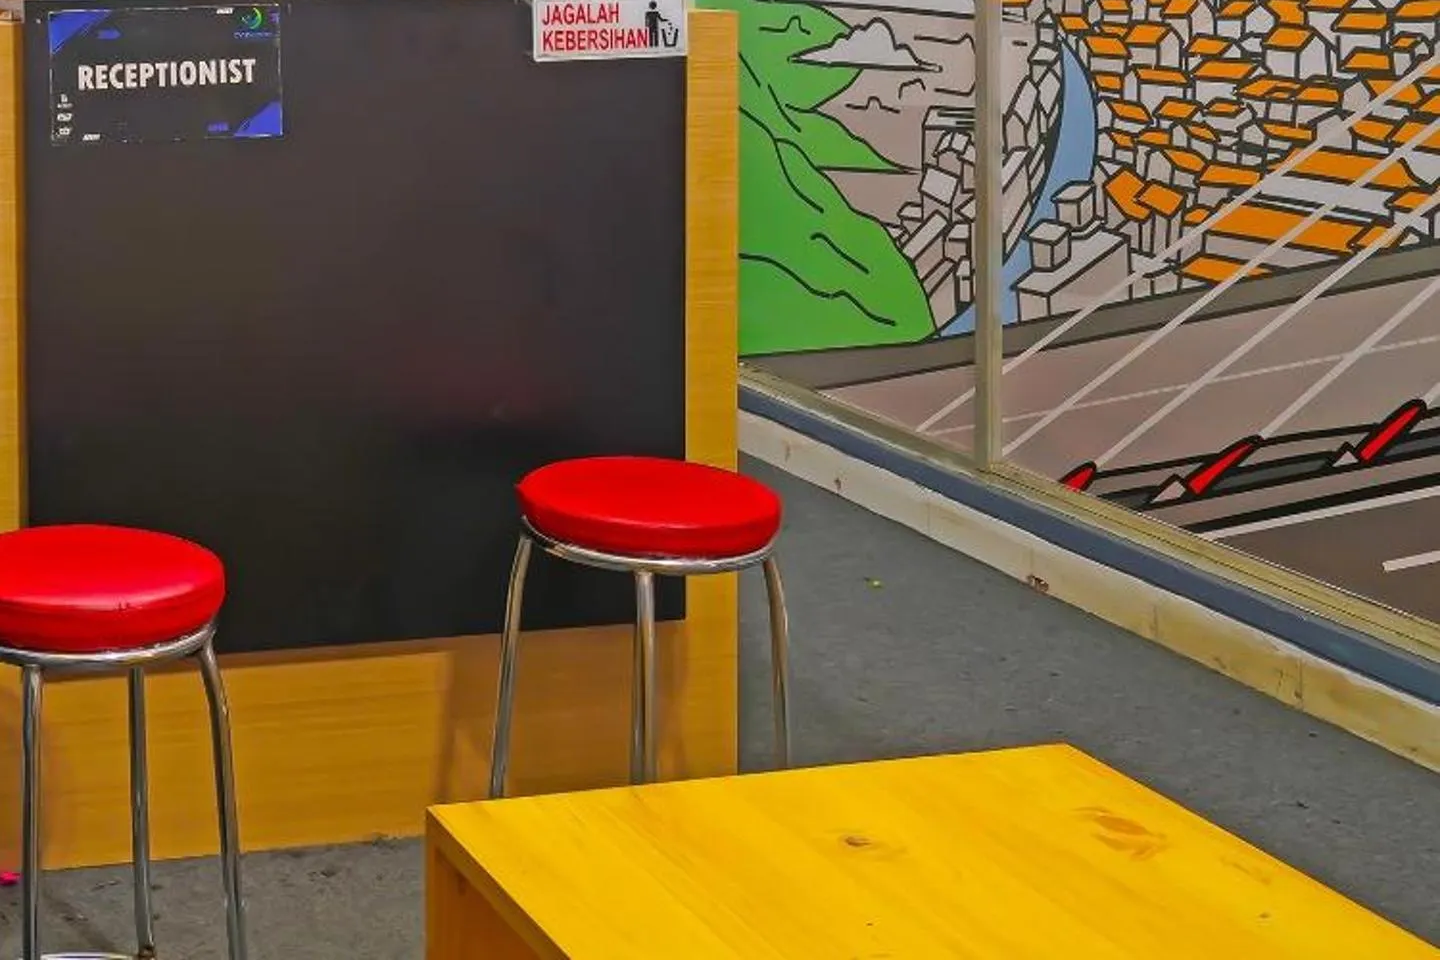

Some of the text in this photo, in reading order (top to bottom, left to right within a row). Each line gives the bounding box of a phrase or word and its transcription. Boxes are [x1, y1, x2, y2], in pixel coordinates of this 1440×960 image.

[542, 2, 619, 25] JAGALAH
[542, 27, 648, 52] KEBERSIHAN
[77, 58, 257, 91] RECEPTIONIST
